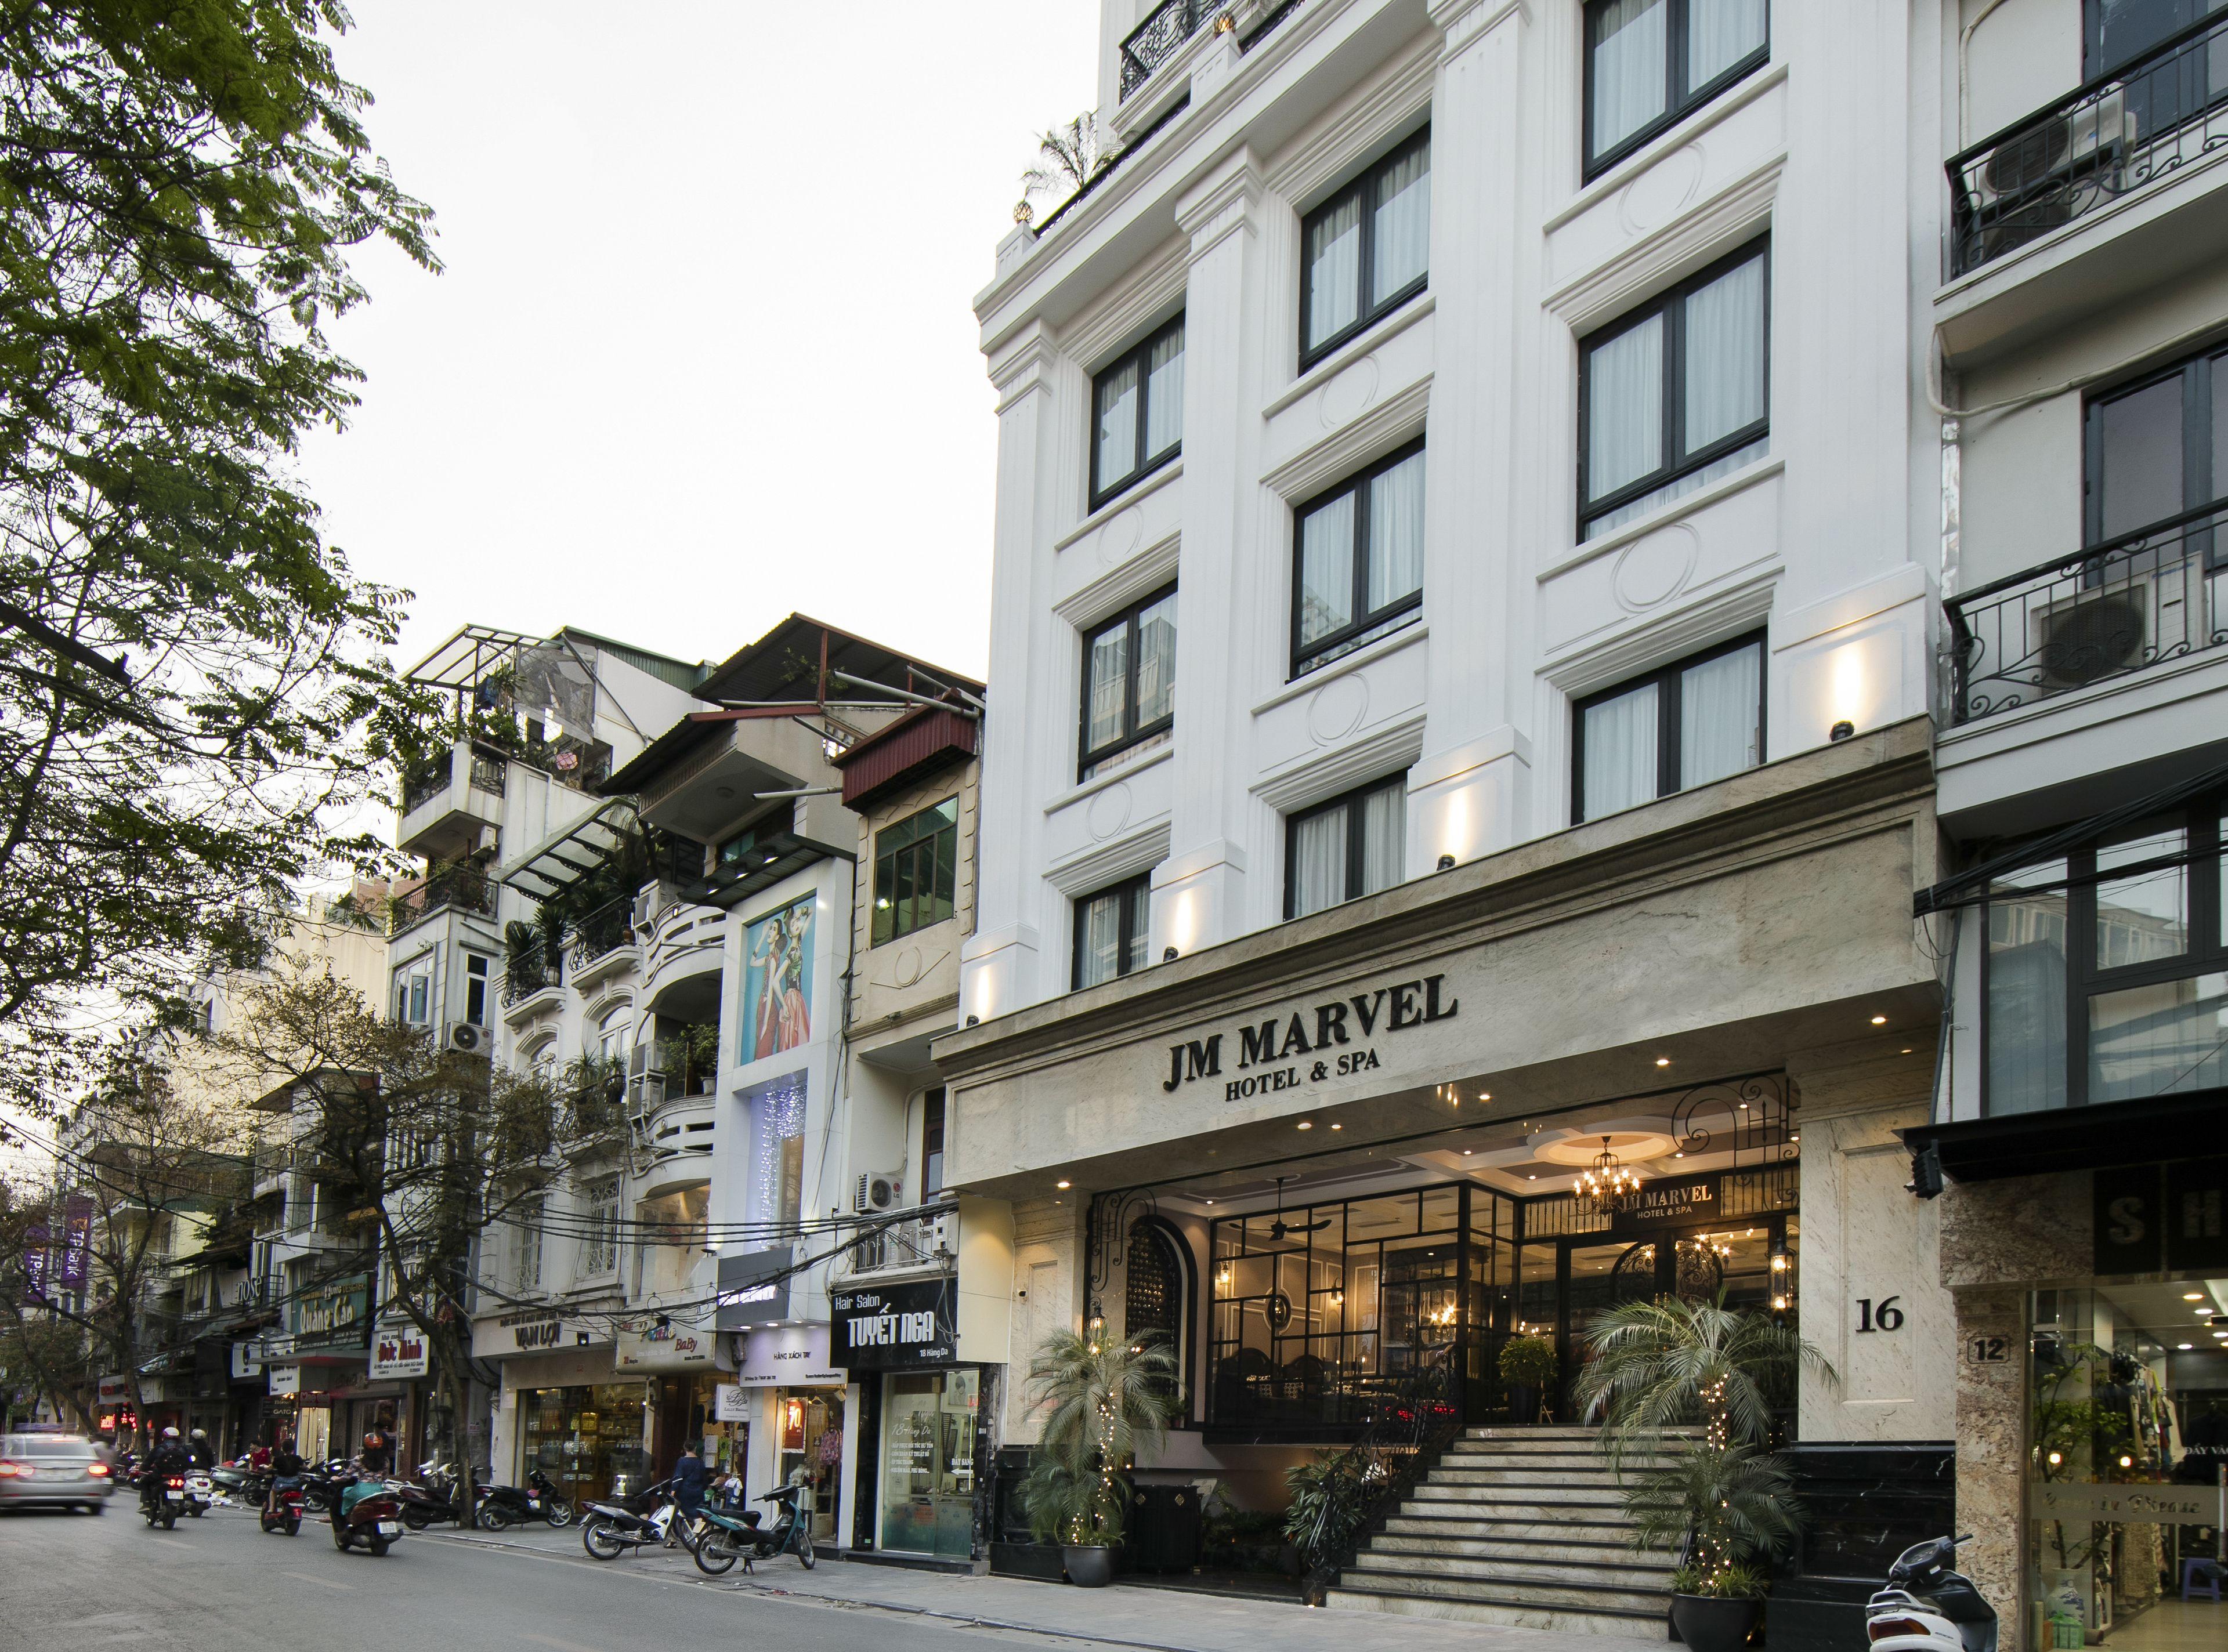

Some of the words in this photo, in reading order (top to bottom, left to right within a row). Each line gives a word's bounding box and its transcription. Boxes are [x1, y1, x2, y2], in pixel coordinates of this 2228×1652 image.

[1163, 1034, 1223, 1092] JM
[1238, 973, 1457, 1068] MARVEL
[1225, 1067, 1300, 1102] HOTEL
[1310, 1061, 1328, 1082] &
[1337, 1048, 1381, 1075] SPA
[1645, 1184, 1712, 1207] MARVEL
[1637, 1208, 1665, 1219] HOTEL
[1676, 1205, 1692, 1214] SPA
[237, 1276, 262, 1302] nose
[836, 1297, 853, 1310] Hair
[857, 1294, 880, 1308] Salon
[847, 1303, 899, 1347] TUYẾT
[1856, 1295, 1904, 1333] 16
[515, 1325, 539, 1350] VẠN
[675, 1337, 697, 1352] BaBy
[927, 1349, 941, 1358] Hàng
[941, 1347, 948, 1356] Da
[1974, 1339, 2004, 1360] 12
[891, 1423, 905, 1436] 18
[921, 1425, 931, 1435] Da
